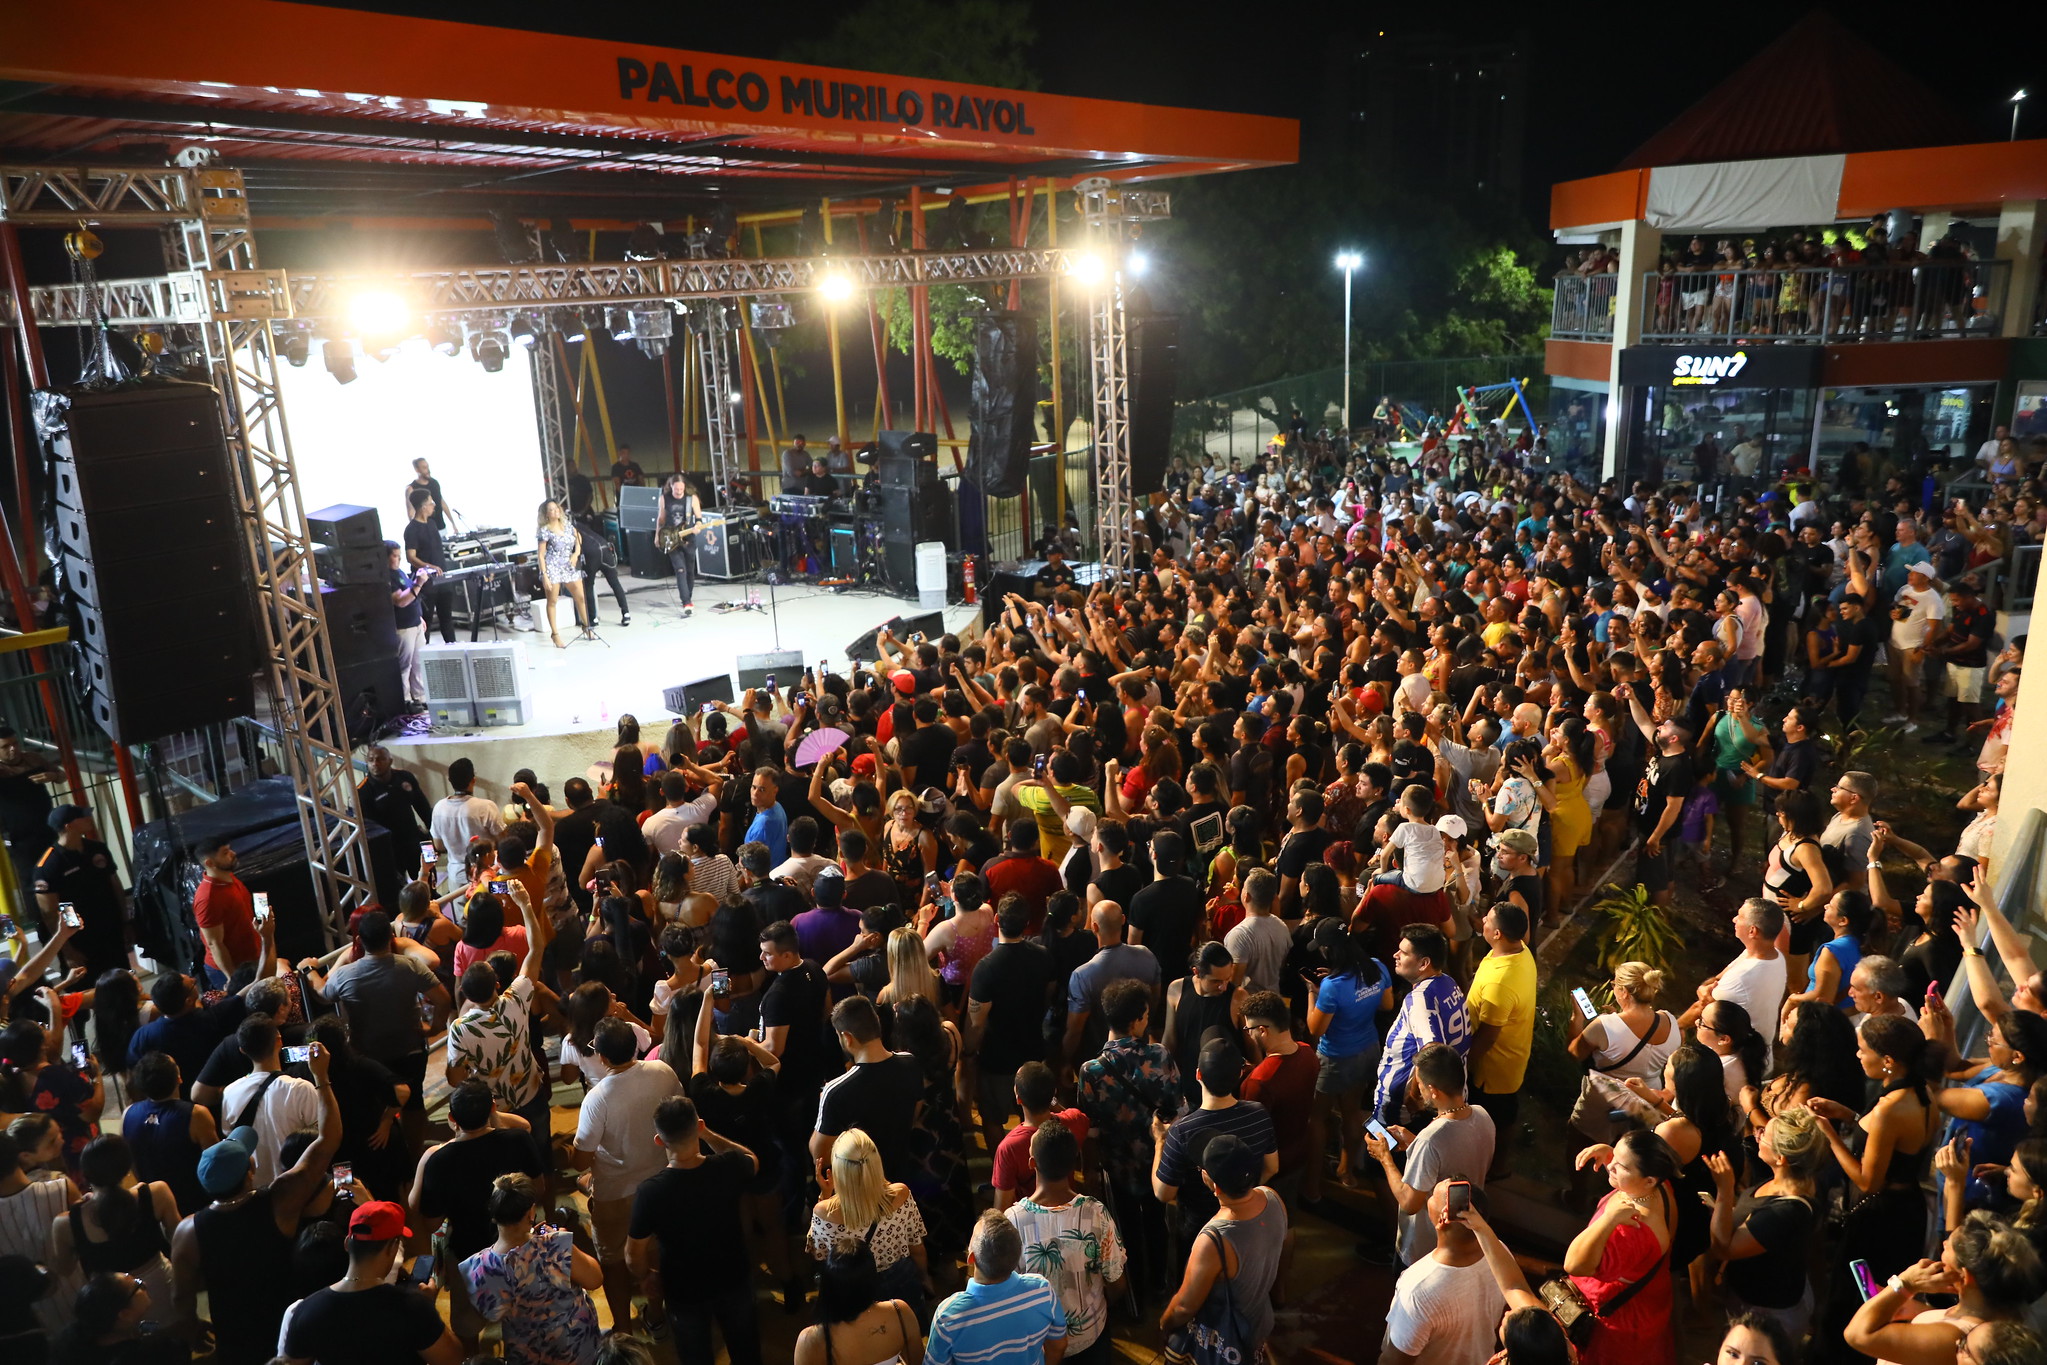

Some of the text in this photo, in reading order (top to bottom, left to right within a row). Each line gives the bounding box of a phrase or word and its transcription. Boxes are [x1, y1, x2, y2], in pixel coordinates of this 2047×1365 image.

[617, 57, 1035, 136] PALCO MURILO RAYOL
[1673, 352, 1747, 377] SUN7
